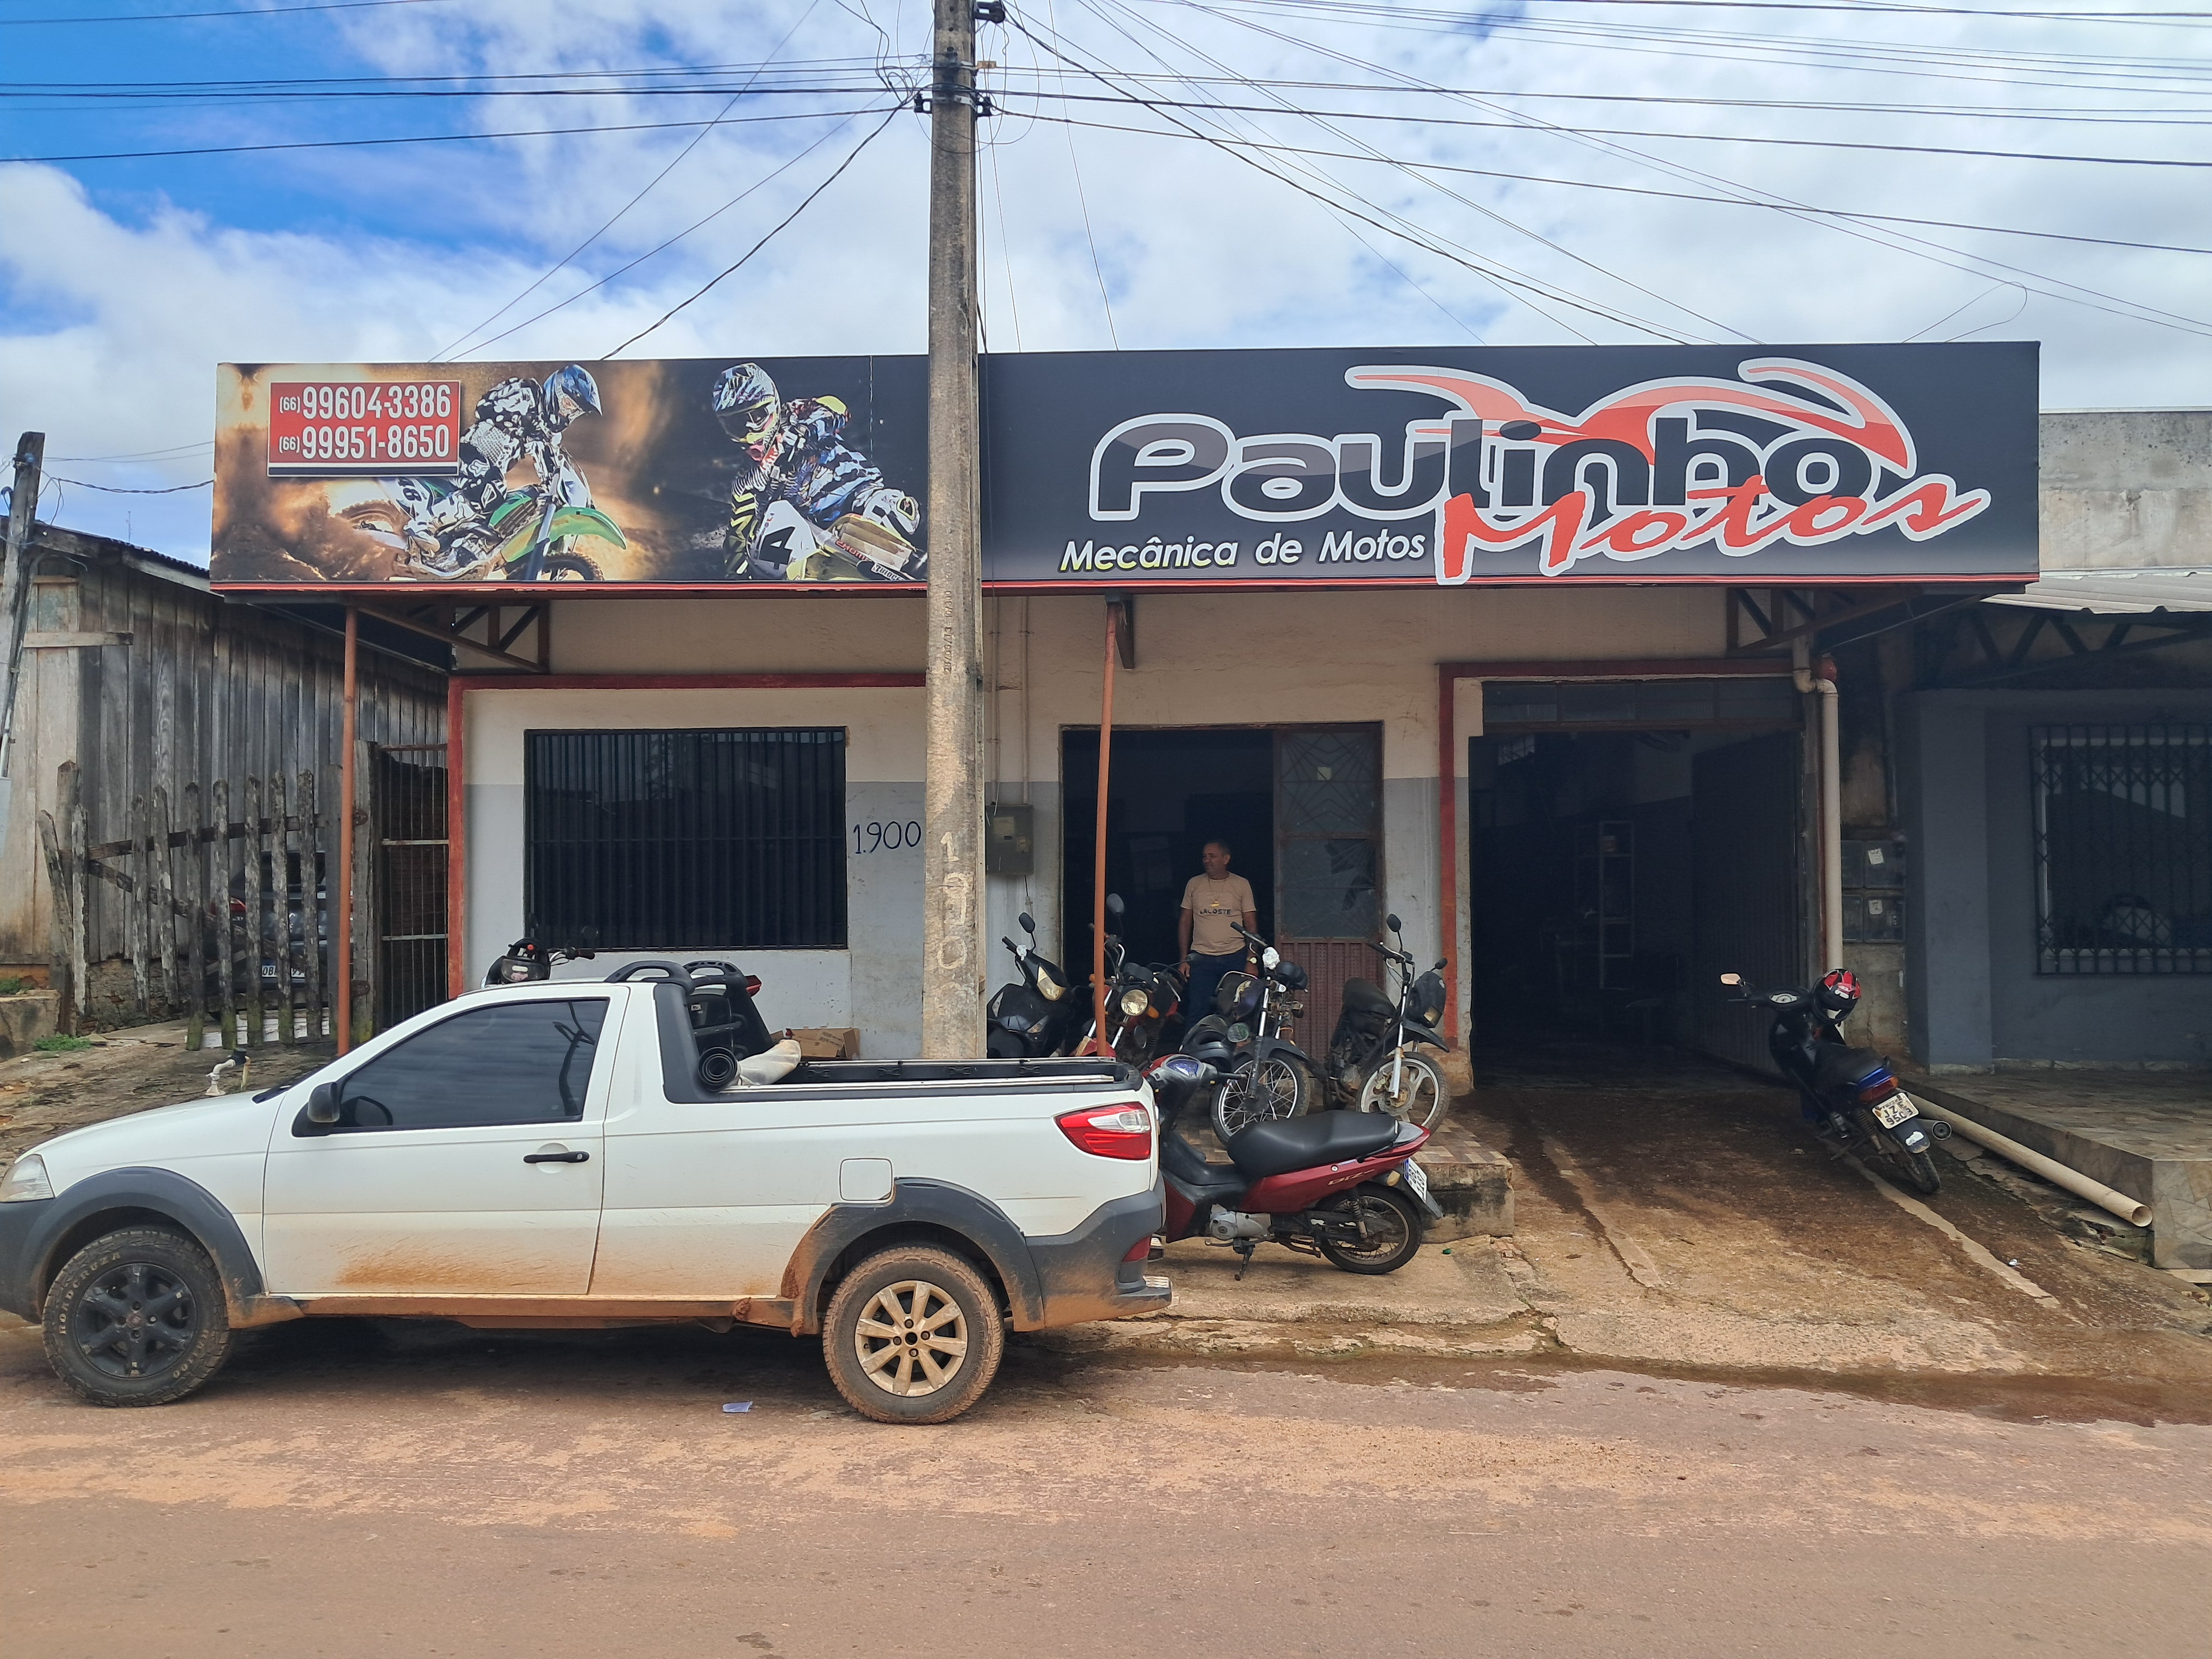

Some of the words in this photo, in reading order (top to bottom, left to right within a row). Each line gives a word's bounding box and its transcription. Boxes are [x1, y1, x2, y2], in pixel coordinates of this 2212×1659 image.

[279, 396, 300, 414] (66)
[302, 384, 451, 420] 99604-3386
[278, 434, 300, 454] (66)
[301, 424, 450, 459] 99951-8650
[1091, 410, 1878, 520] Paulinho
[1059, 536, 1239, 573] Mecânica
[1255, 532, 1303, 566] de
[1318, 528, 1425, 562] Motos
[1442, 473, 1985, 580] Motos
[59, 1251, 122, 1336] ROADCRUZA
